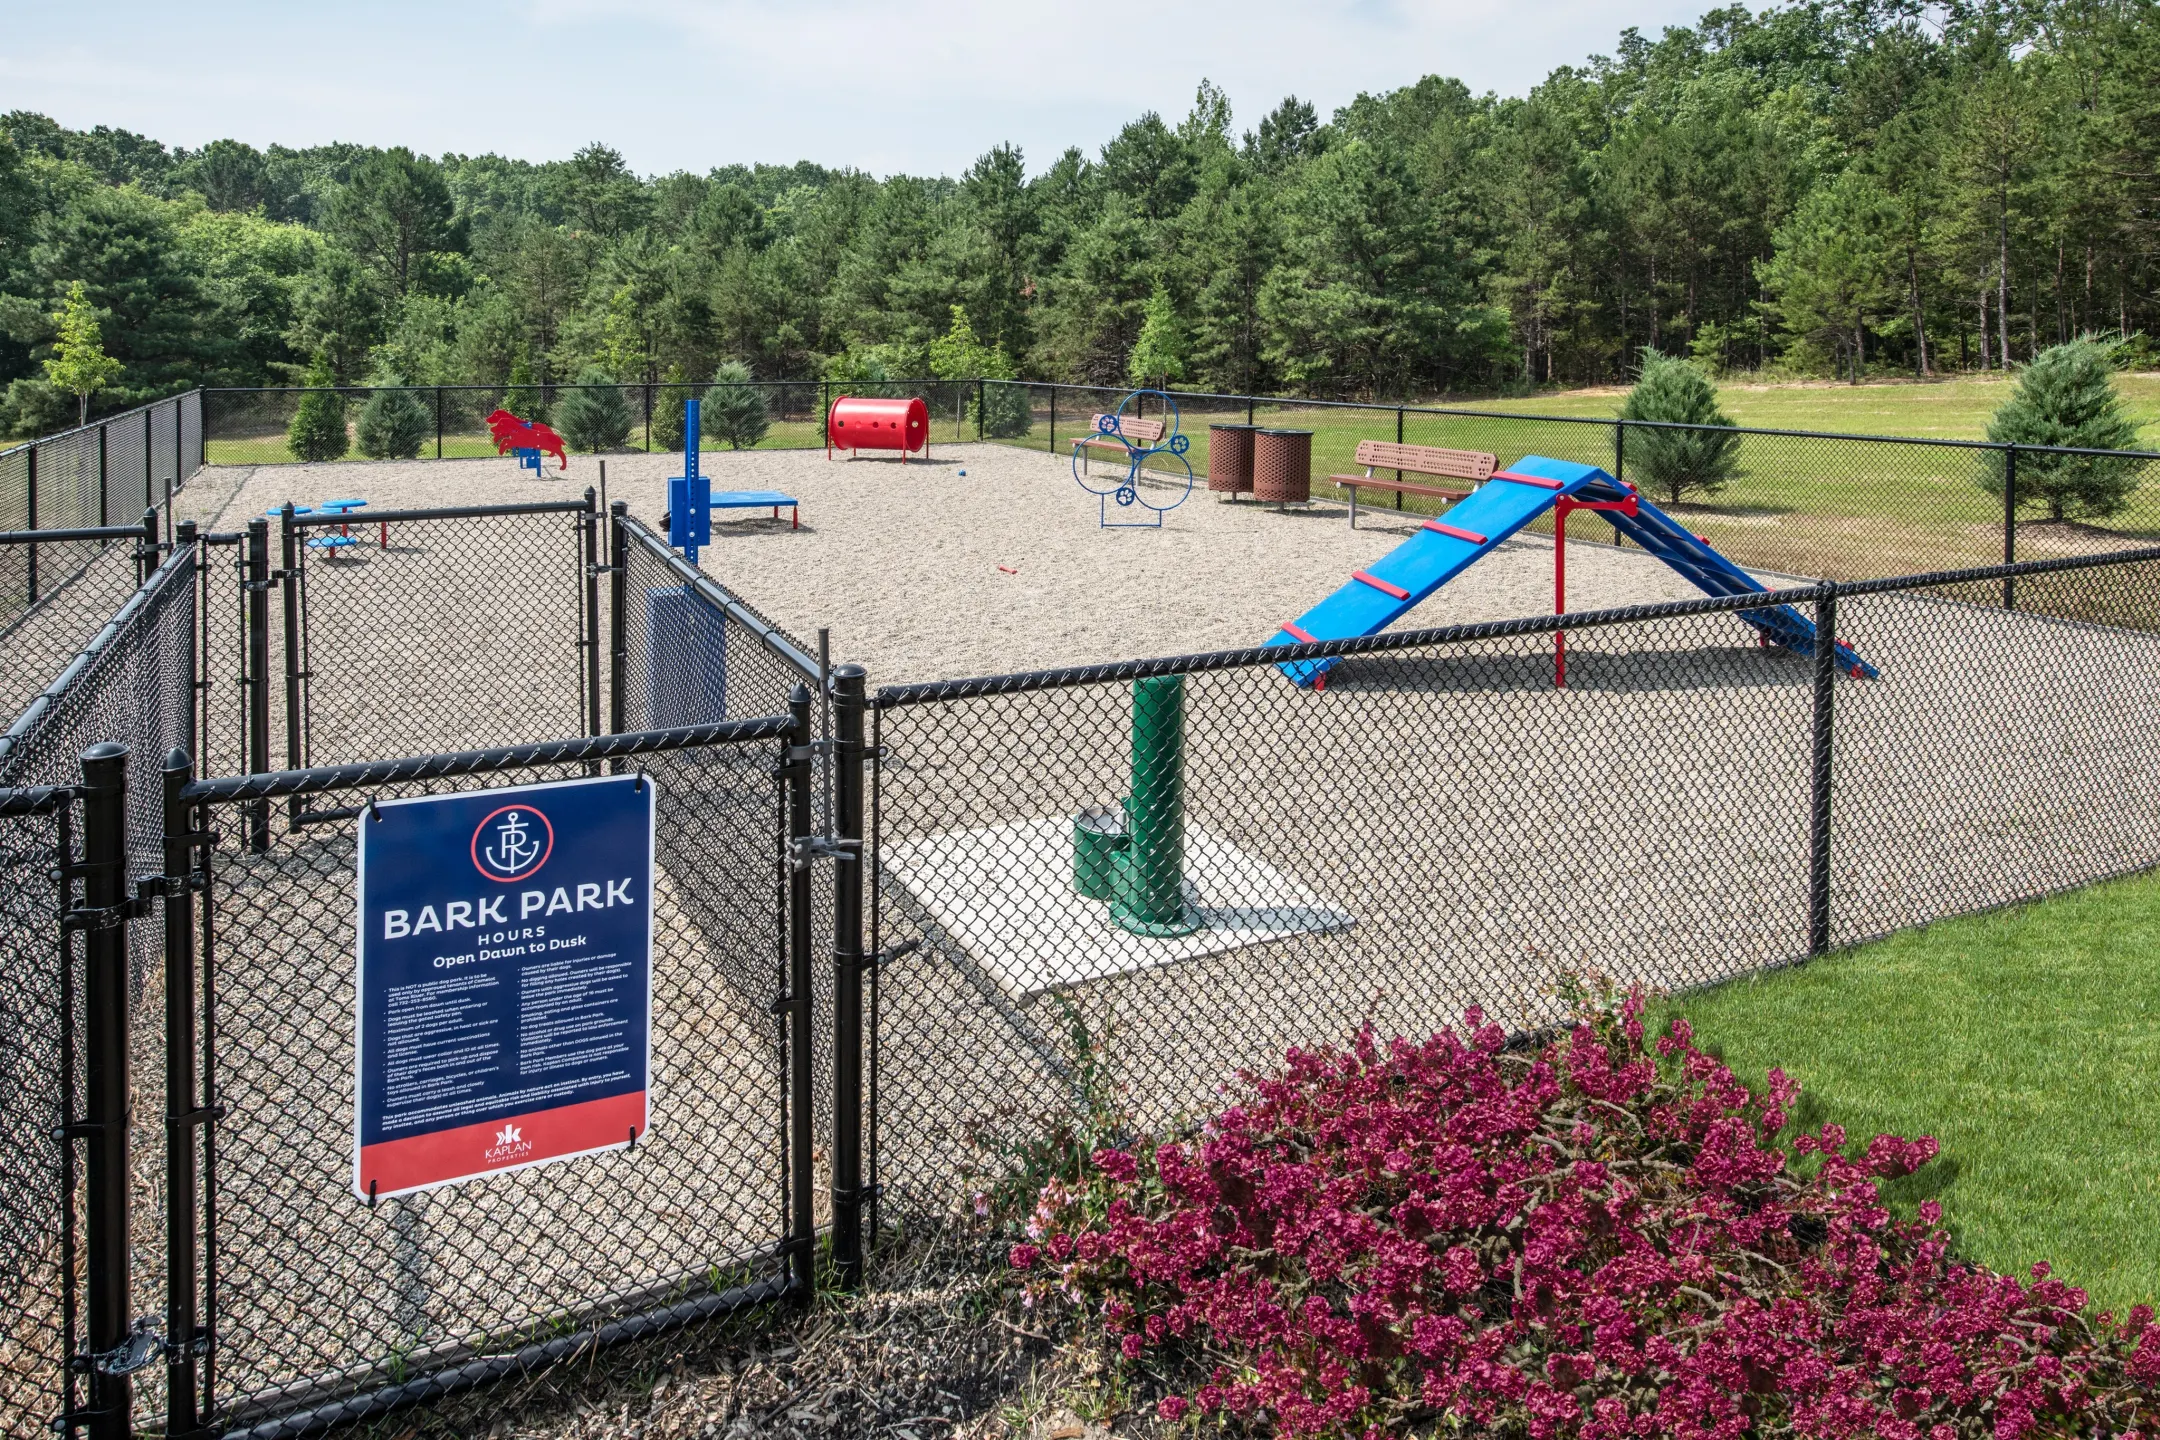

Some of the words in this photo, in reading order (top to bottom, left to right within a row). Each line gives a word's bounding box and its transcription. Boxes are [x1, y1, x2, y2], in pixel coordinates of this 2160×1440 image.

[385, 895, 507, 939] BARK
[521, 878, 634, 919] PARK
[478, 926, 545, 945] HOURS
[434, 954, 475, 968] Open
[480, 947, 525, 960] Dawn
[529, 943, 545, 953] to
[550, 935, 586, 950] Dusk
[486, 1141, 531, 1158] KAPLAN
[488, 1152, 528, 1163] PROPERTIES
